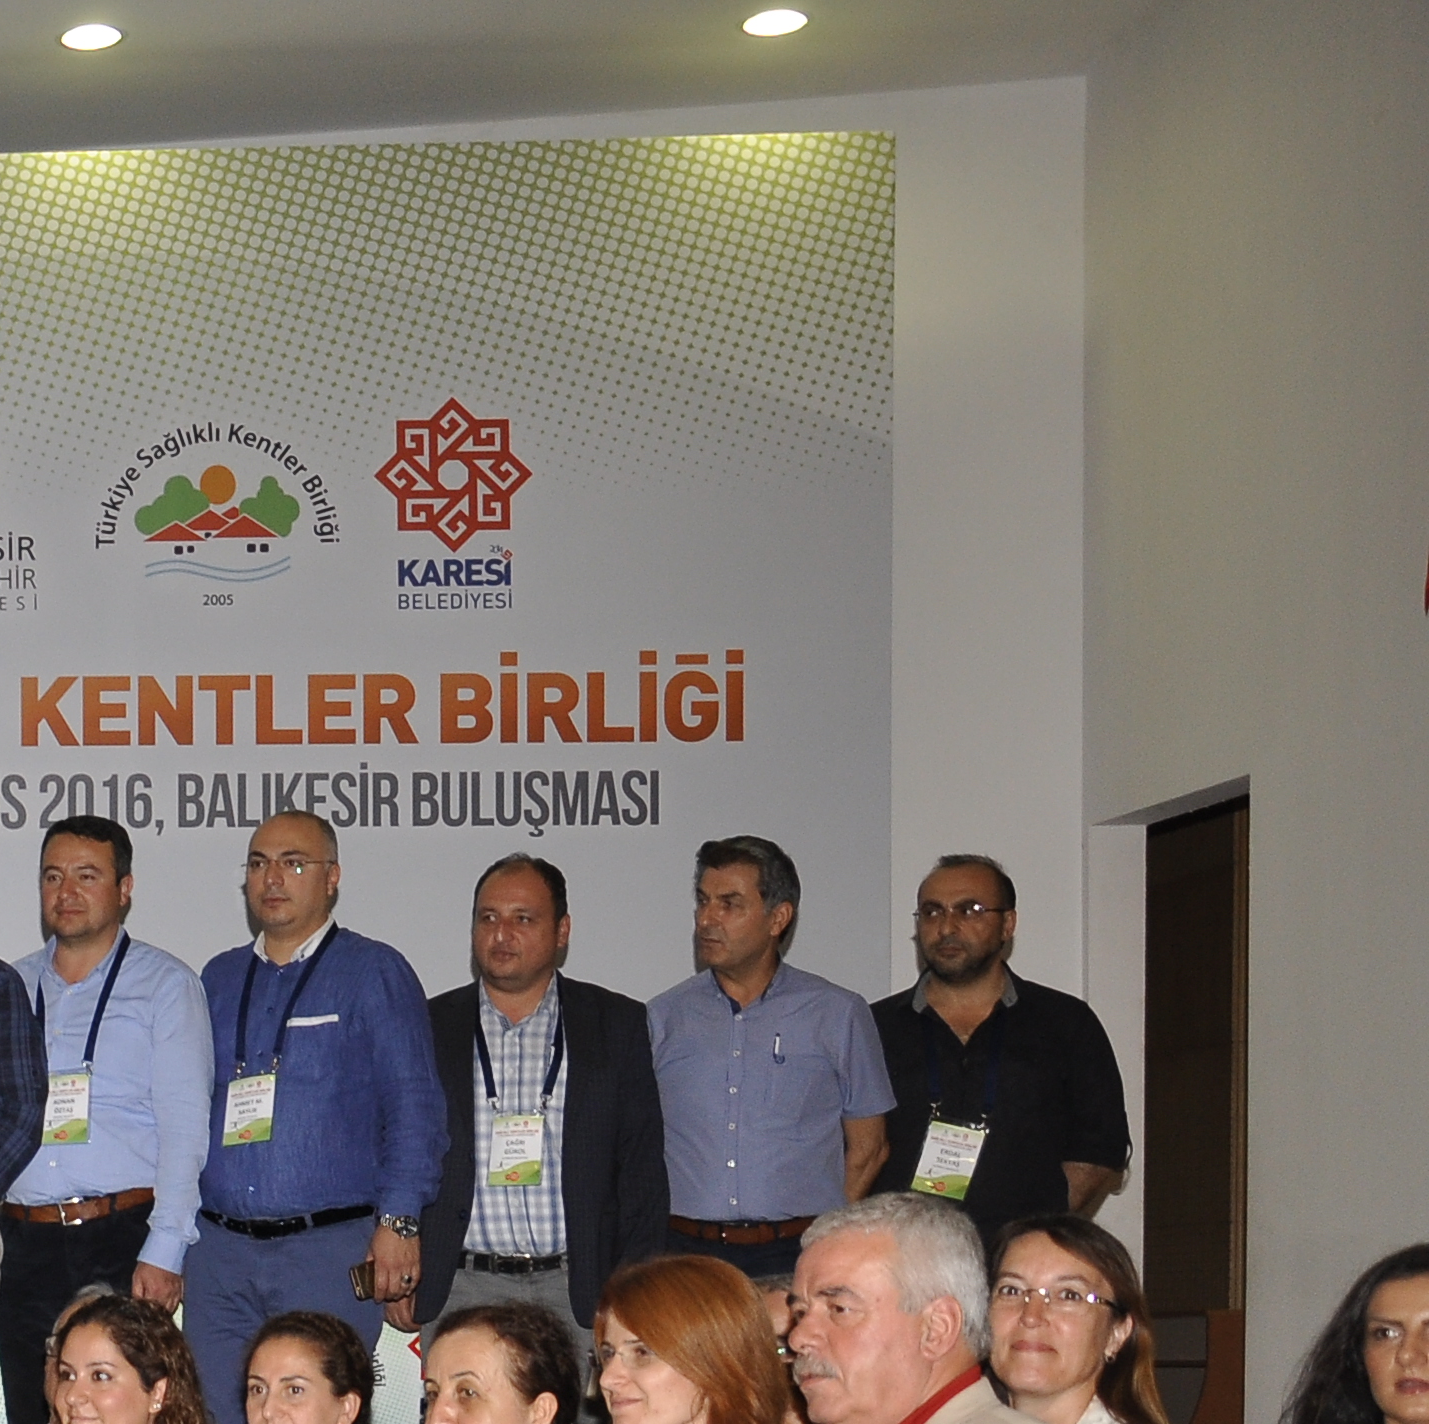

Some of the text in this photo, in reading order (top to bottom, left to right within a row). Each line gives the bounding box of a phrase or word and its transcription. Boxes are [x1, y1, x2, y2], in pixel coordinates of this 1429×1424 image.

[95, 421, 340, 550] Türkiye Sağlıklı Kentler Birliği
[202, 594, 234, 606] 2005
[398, 589, 513, 610] BELEDİYESİ
[20, 673, 419, 747] KENTLER
[440, 649, 745, 744] BİRLİĞİ
[39, 773, 165, 836] 2016,
[177, 762, 399, 829] BALIKESİR
[411, 769, 659, 837] BULUŞMASI
